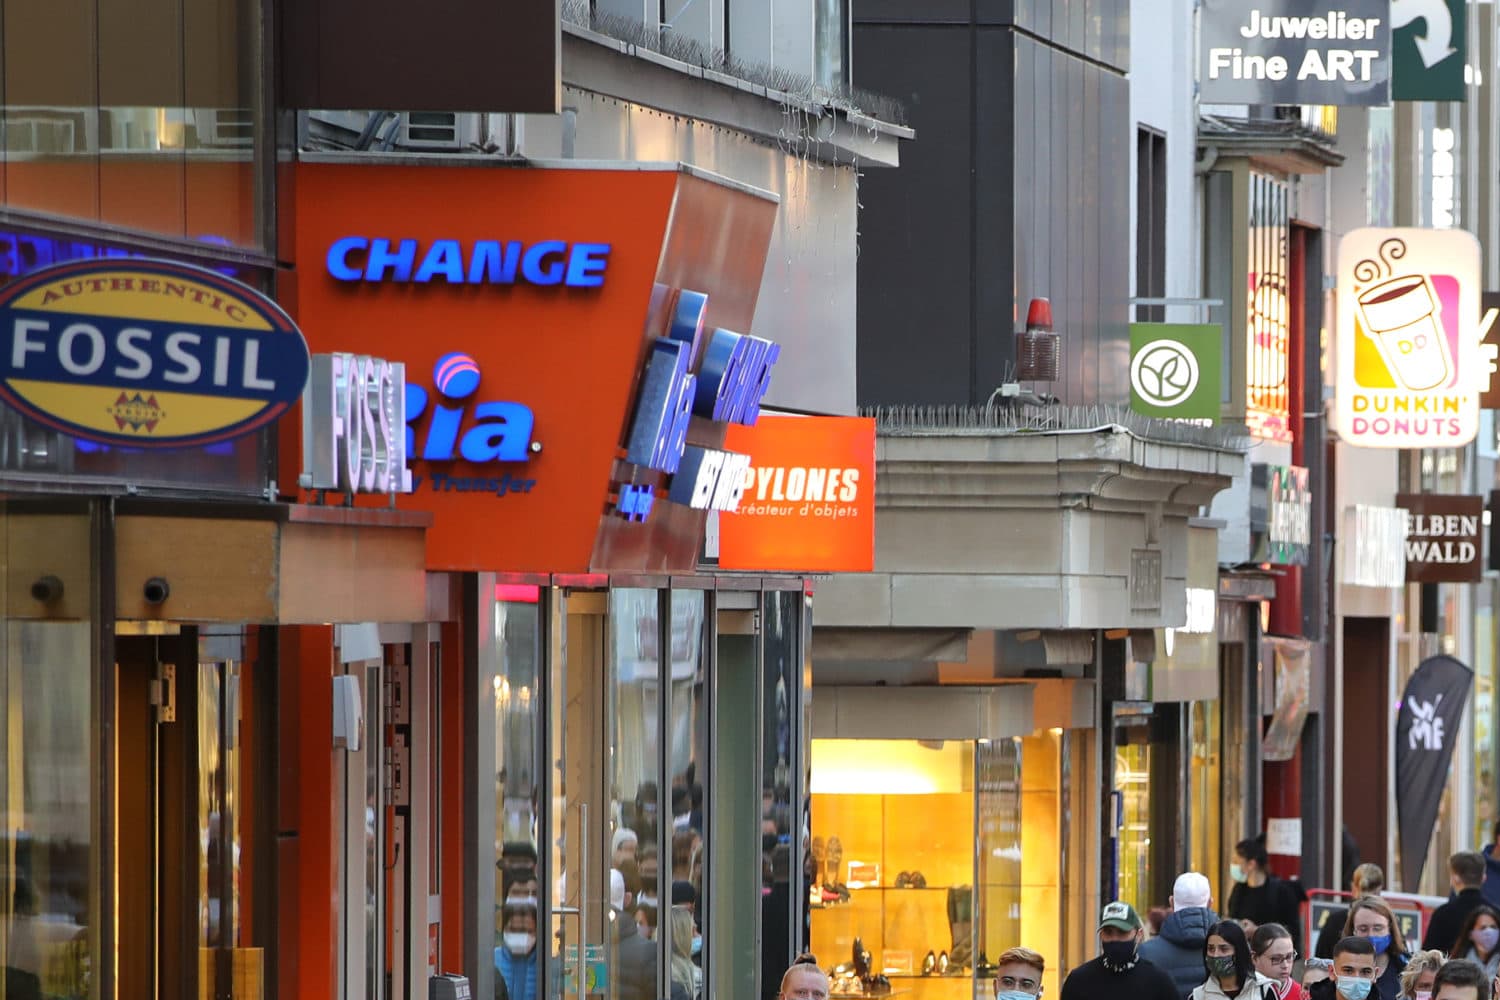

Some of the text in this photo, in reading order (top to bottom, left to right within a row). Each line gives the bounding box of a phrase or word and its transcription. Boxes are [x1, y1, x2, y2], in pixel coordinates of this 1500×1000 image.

[1240, 9, 1380, 40] Juwelier
[1209, 47, 1379, 81] Fine ART
[326, 236, 611, 288] CHANGE
[40, 277, 248, 323] AUTHENTIC
[11, 317, 276, 391] FOSSIL
[1352, 395, 1469, 414] DUNKIN'
[1352, 418, 1462, 437] DONUTS
[799, 503, 858, 519] d'objets
[1406, 542, 1476, 564] WALD
